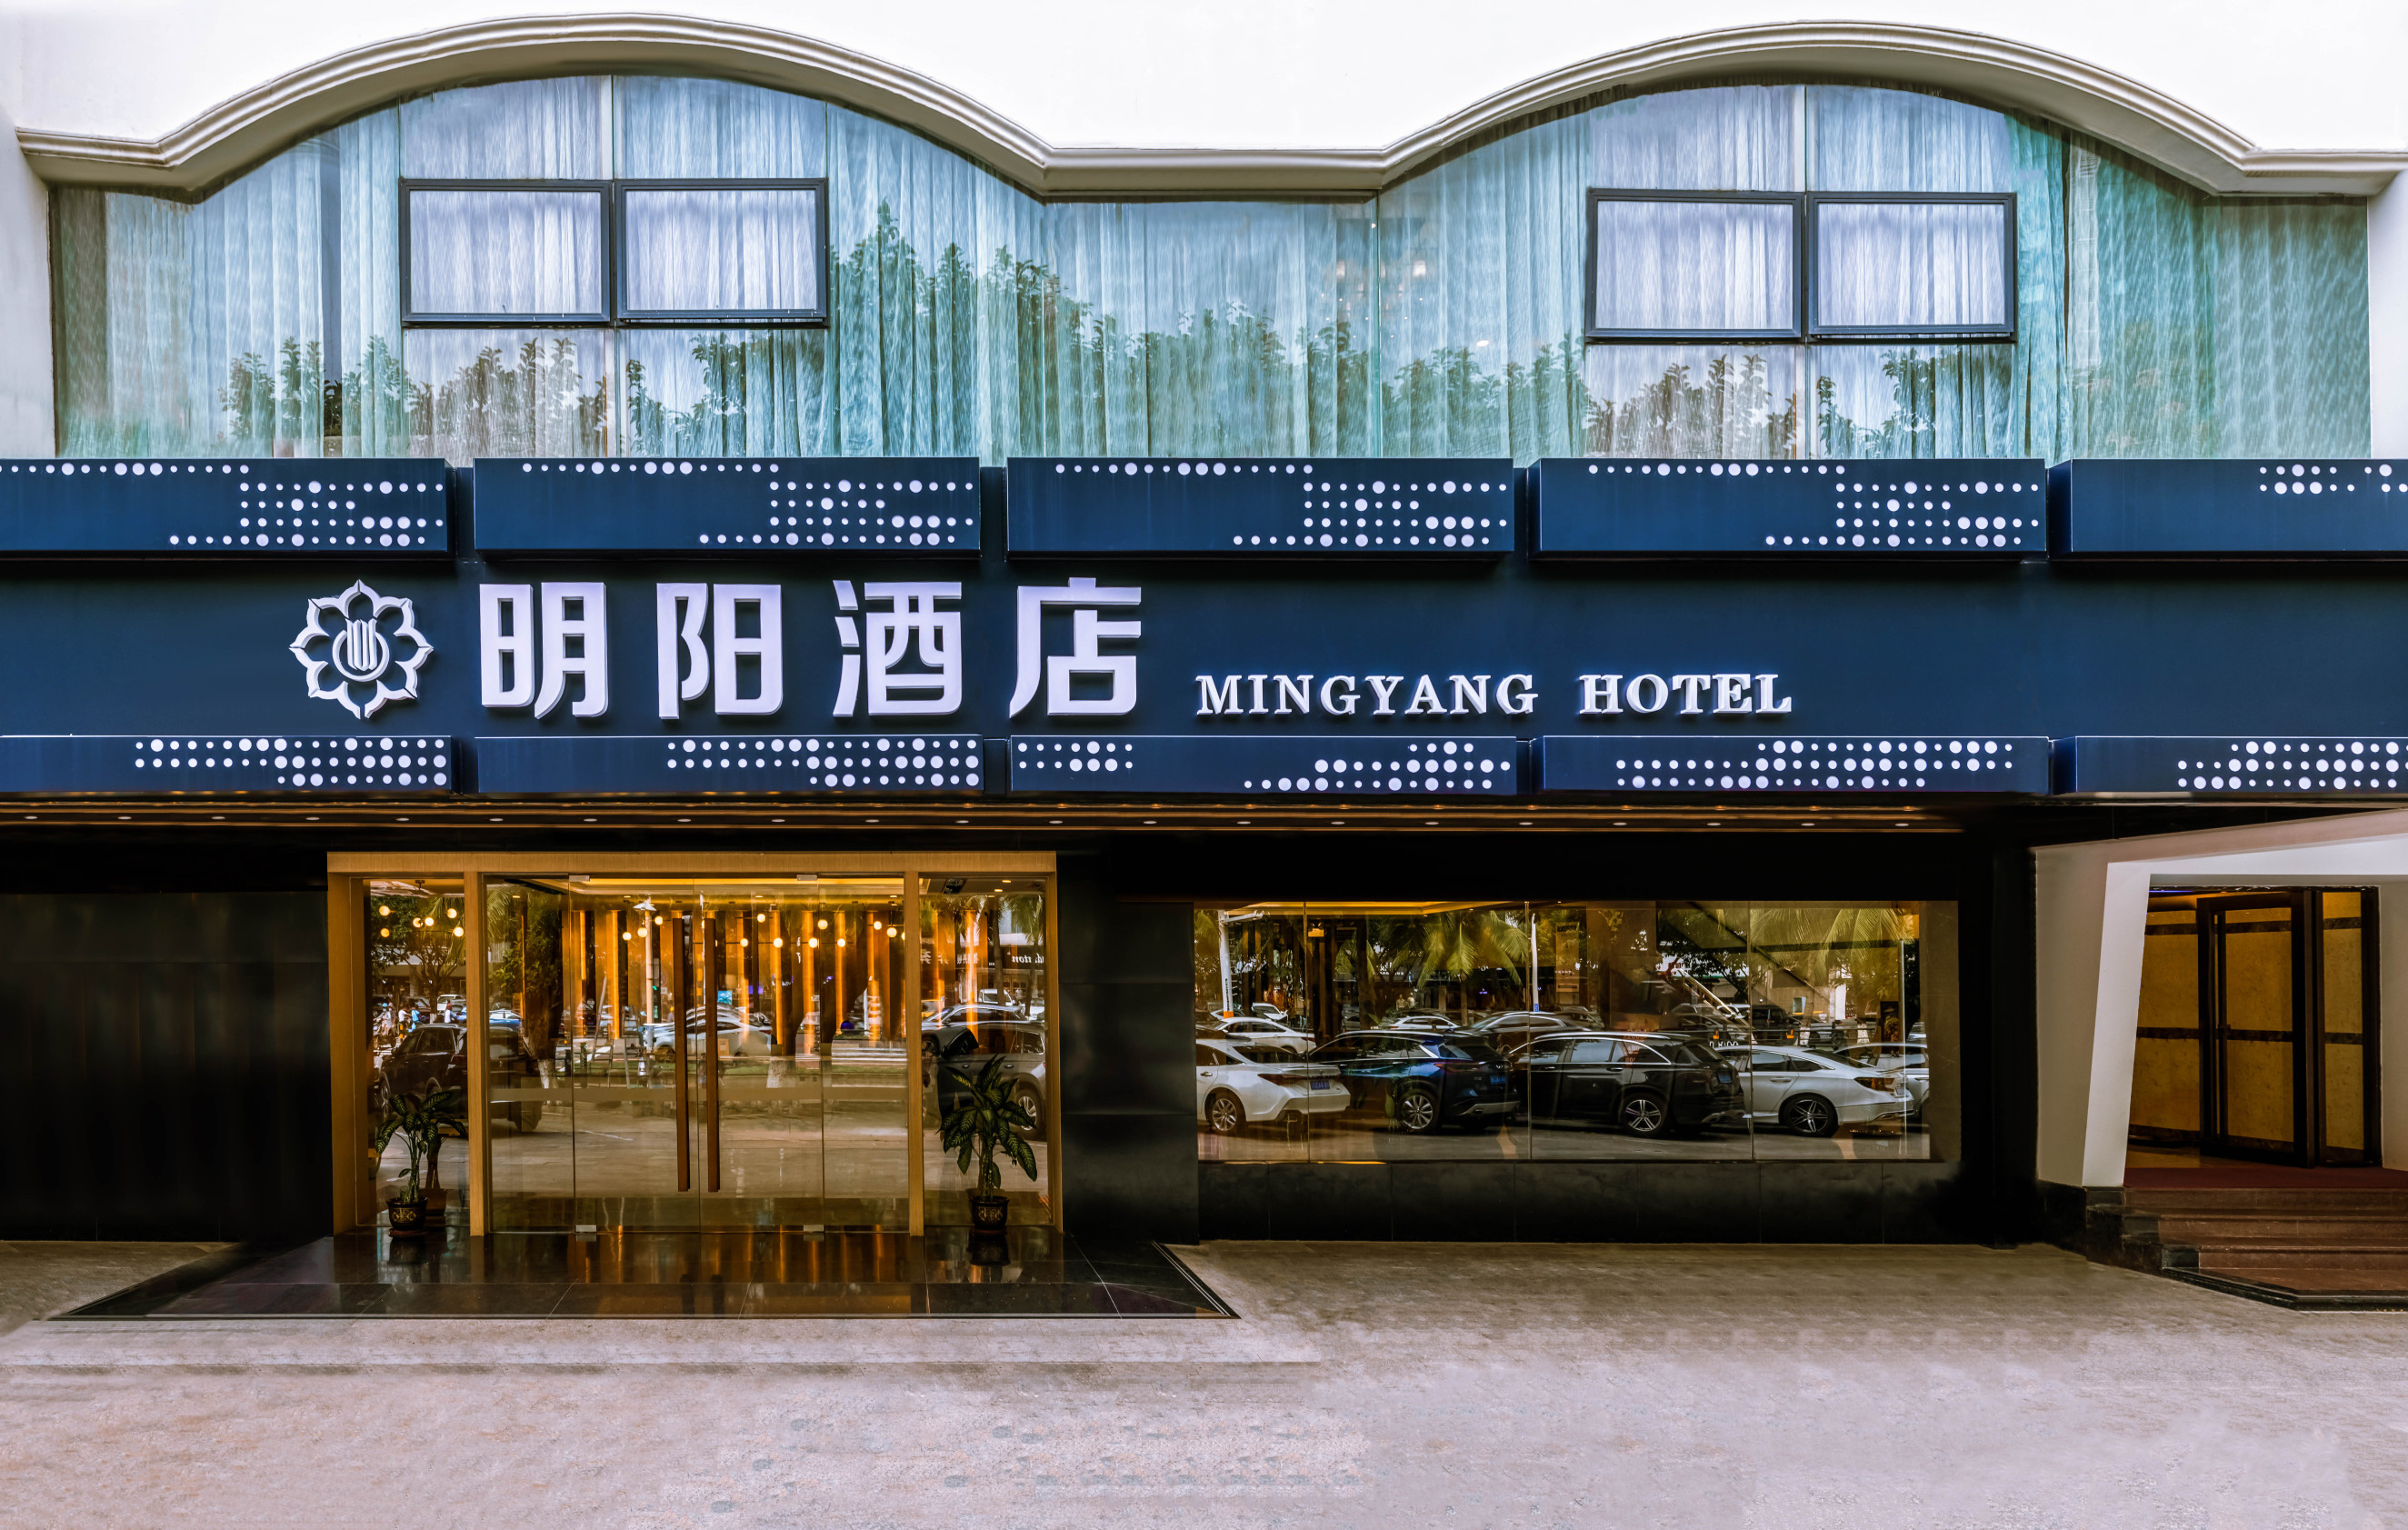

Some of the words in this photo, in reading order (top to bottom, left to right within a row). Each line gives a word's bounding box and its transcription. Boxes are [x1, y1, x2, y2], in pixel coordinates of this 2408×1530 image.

[479, 577, 1143, 720] 明阳酒店
[1194, 674, 1539, 715] MINGYANG
[1578, 673, 1793, 715] HOTEL
